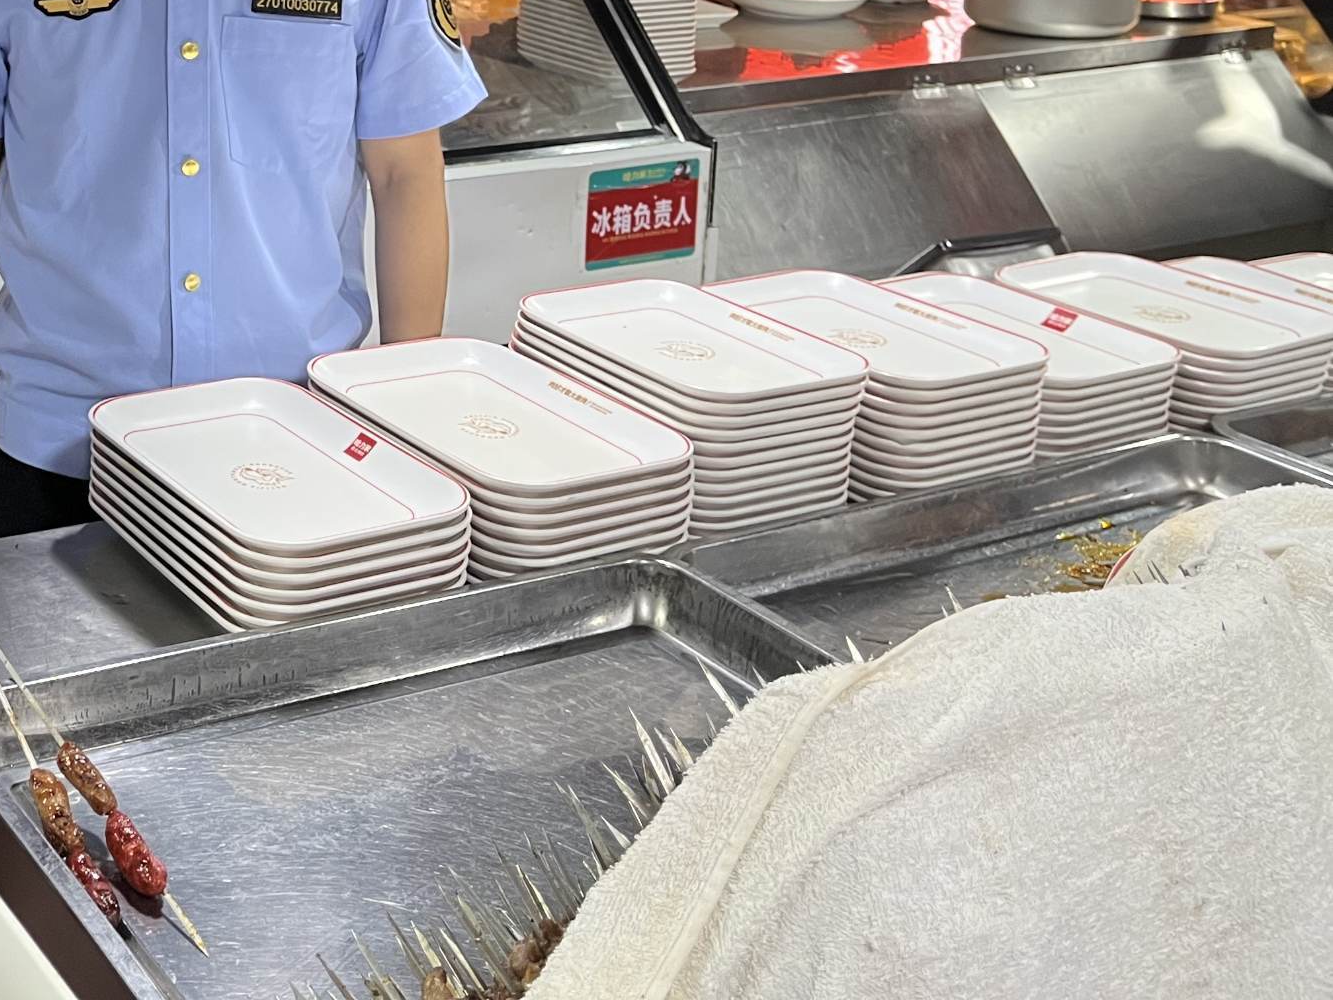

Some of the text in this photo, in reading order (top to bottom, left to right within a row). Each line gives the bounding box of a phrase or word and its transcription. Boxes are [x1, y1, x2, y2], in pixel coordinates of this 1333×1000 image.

[591, 195, 693, 238] 冰箱负责人
